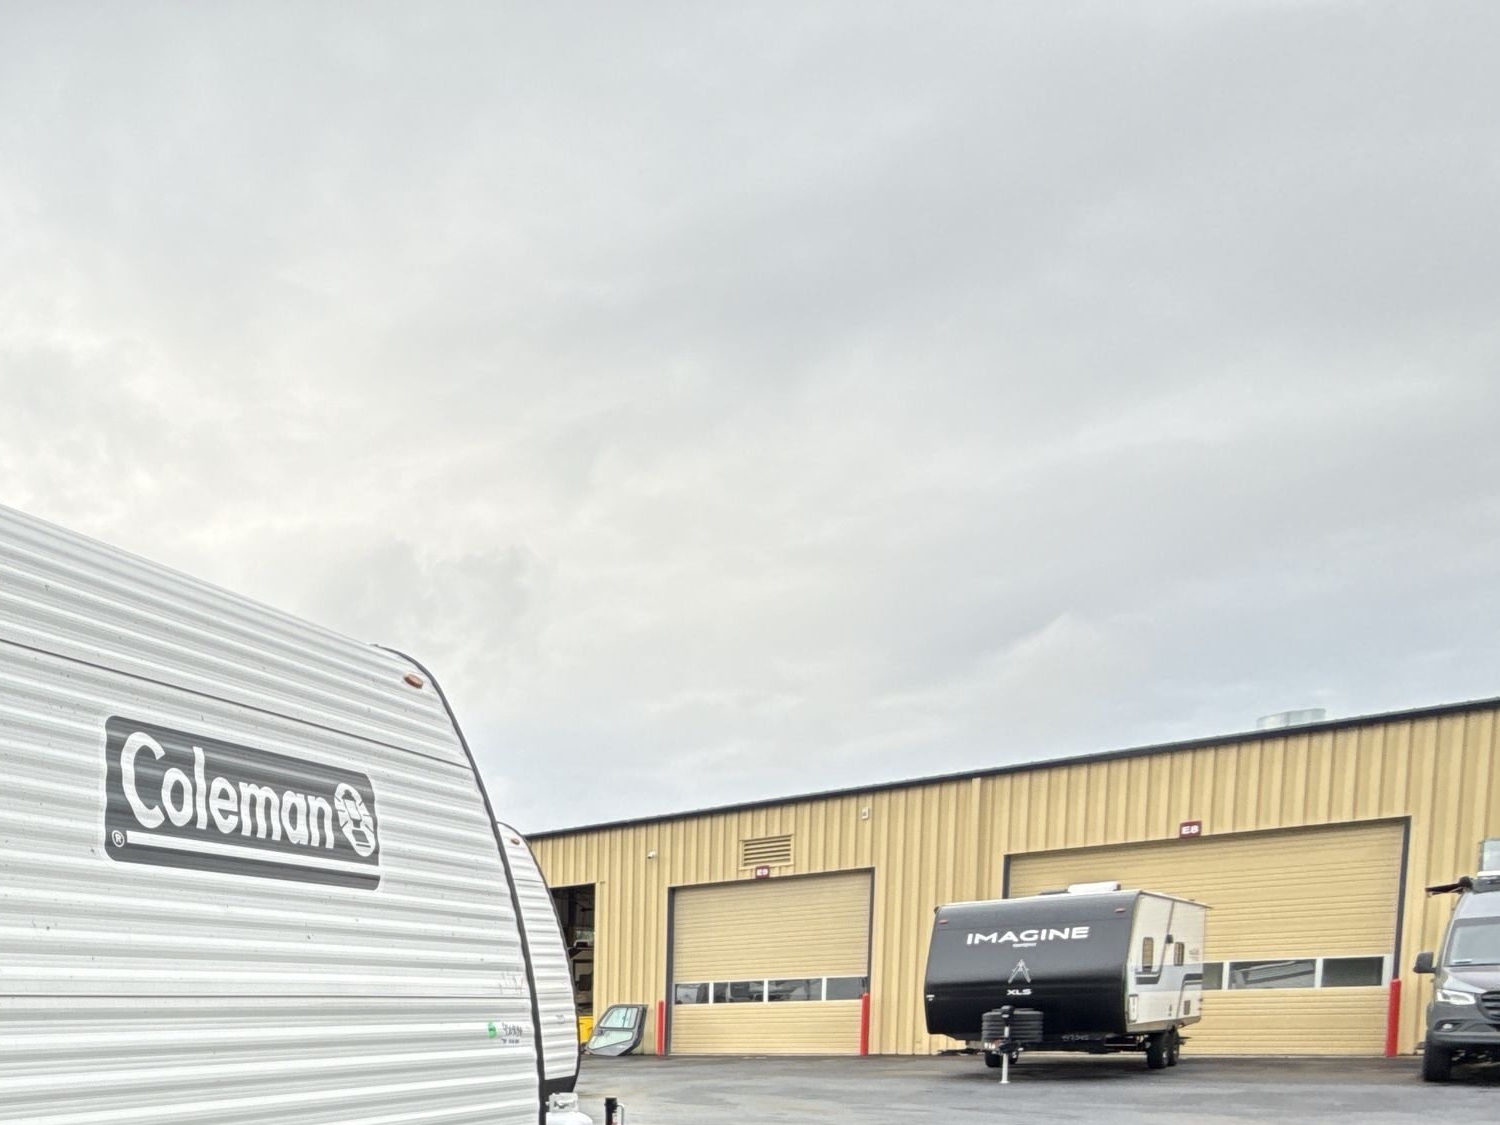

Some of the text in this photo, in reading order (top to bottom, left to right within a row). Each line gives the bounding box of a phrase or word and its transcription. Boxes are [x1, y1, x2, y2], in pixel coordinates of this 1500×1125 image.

[120, 731, 335, 849] Coleman
[966, 926, 1091, 945] IMAGINE
[1006, 988, 1032, 996] XLS
